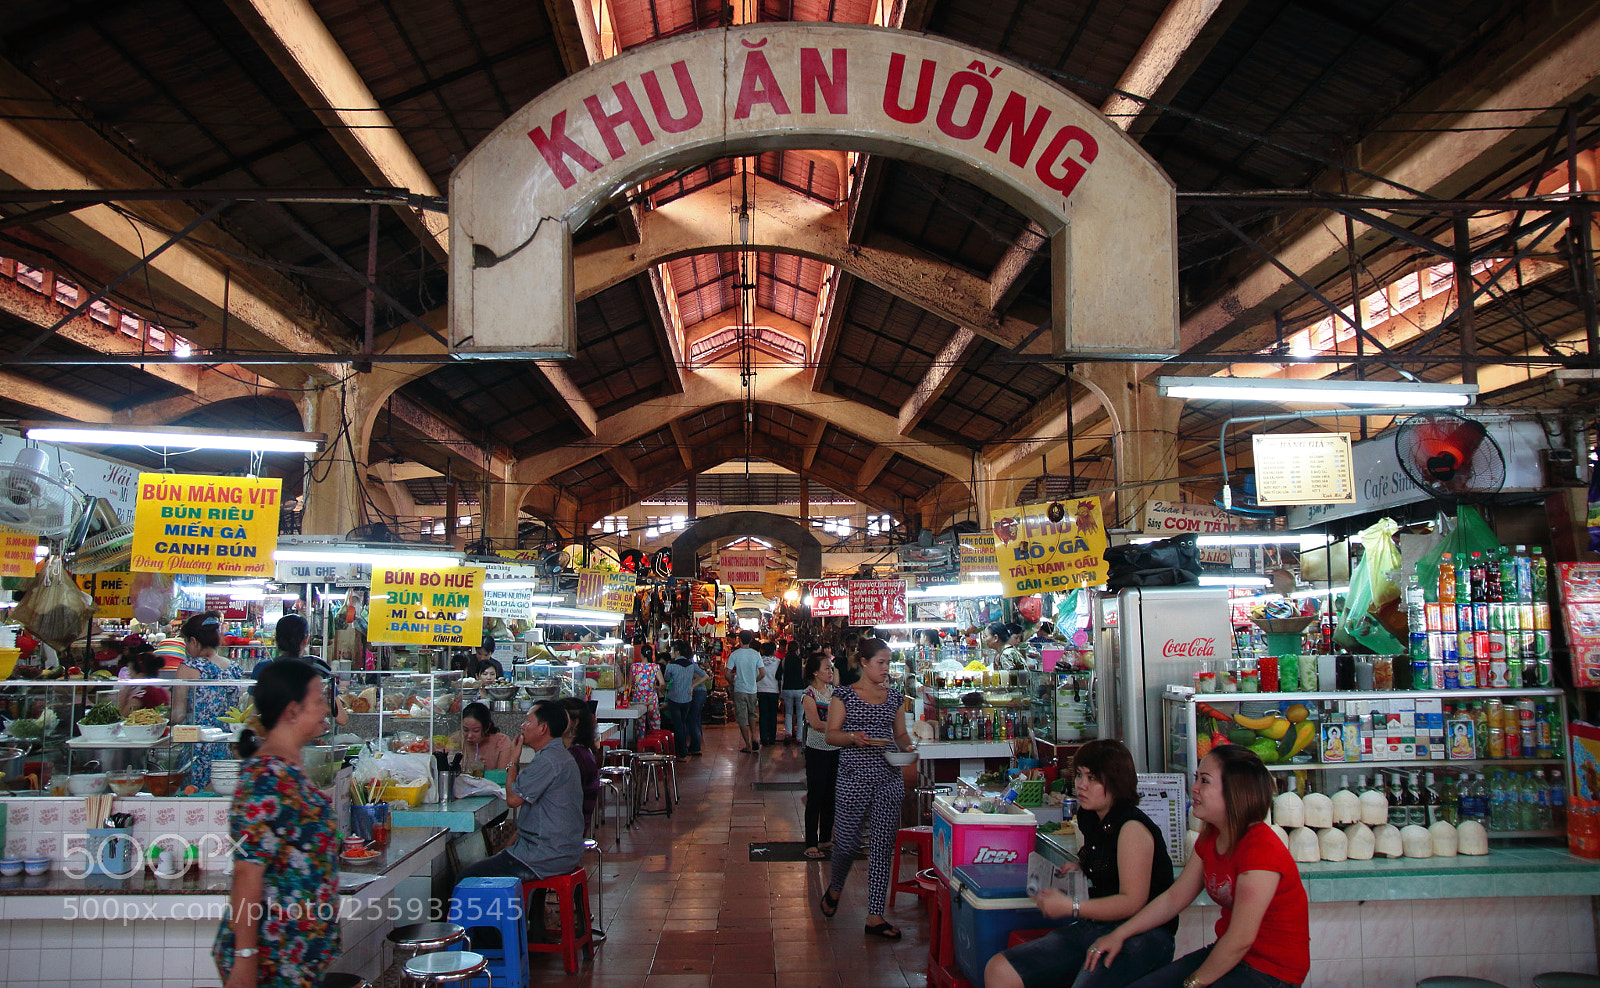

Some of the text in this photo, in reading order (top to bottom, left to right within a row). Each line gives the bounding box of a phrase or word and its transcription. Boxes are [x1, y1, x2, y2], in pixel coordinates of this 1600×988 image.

[527, 38, 1100, 197] KHU ĂN UỐNG
[142, 480, 279, 508] BÚN MĂNG VỊT
[1364, 475, 1389, 503] Café
[161, 504, 254, 521] BÚN RIÊU
[1152, 502, 1180, 514] Quán
[164, 522, 248, 540] MIẾN GÀ
[1164, 517, 1201, 532] CƠM
[1204, 518, 1237, 533] TẤM
[154, 542, 257, 558] CANH BÚN
[1014, 536, 1090, 560] BÒ GÀ
[133, 555, 164, 570] Đông
[168, 555, 213, 572] Phương
[217, 562, 242, 572] Kính
[244, 564, 265, 573] mời
[292, 566, 311, 576] CUA
[1008, 564, 1028, 578] TÁI
[1037, 562, 1065, 574] NẠM
[101, 578, 123, 590] PHÊ
[384, 569, 478, 588] BÚN BÒ HUẾ
[386, 590, 470, 608] BÚN MẮM
[814, 586, 829, 598] BÚN
[392, 608, 407, 619] MÌ
[390, 620, 462, 634] BÁNH BÈO
[432, 634, 450, 643] KÍNH
[1162, 637, 1216, 658] Coca-Cola
[973, 846, 1018, 864] Ice+
